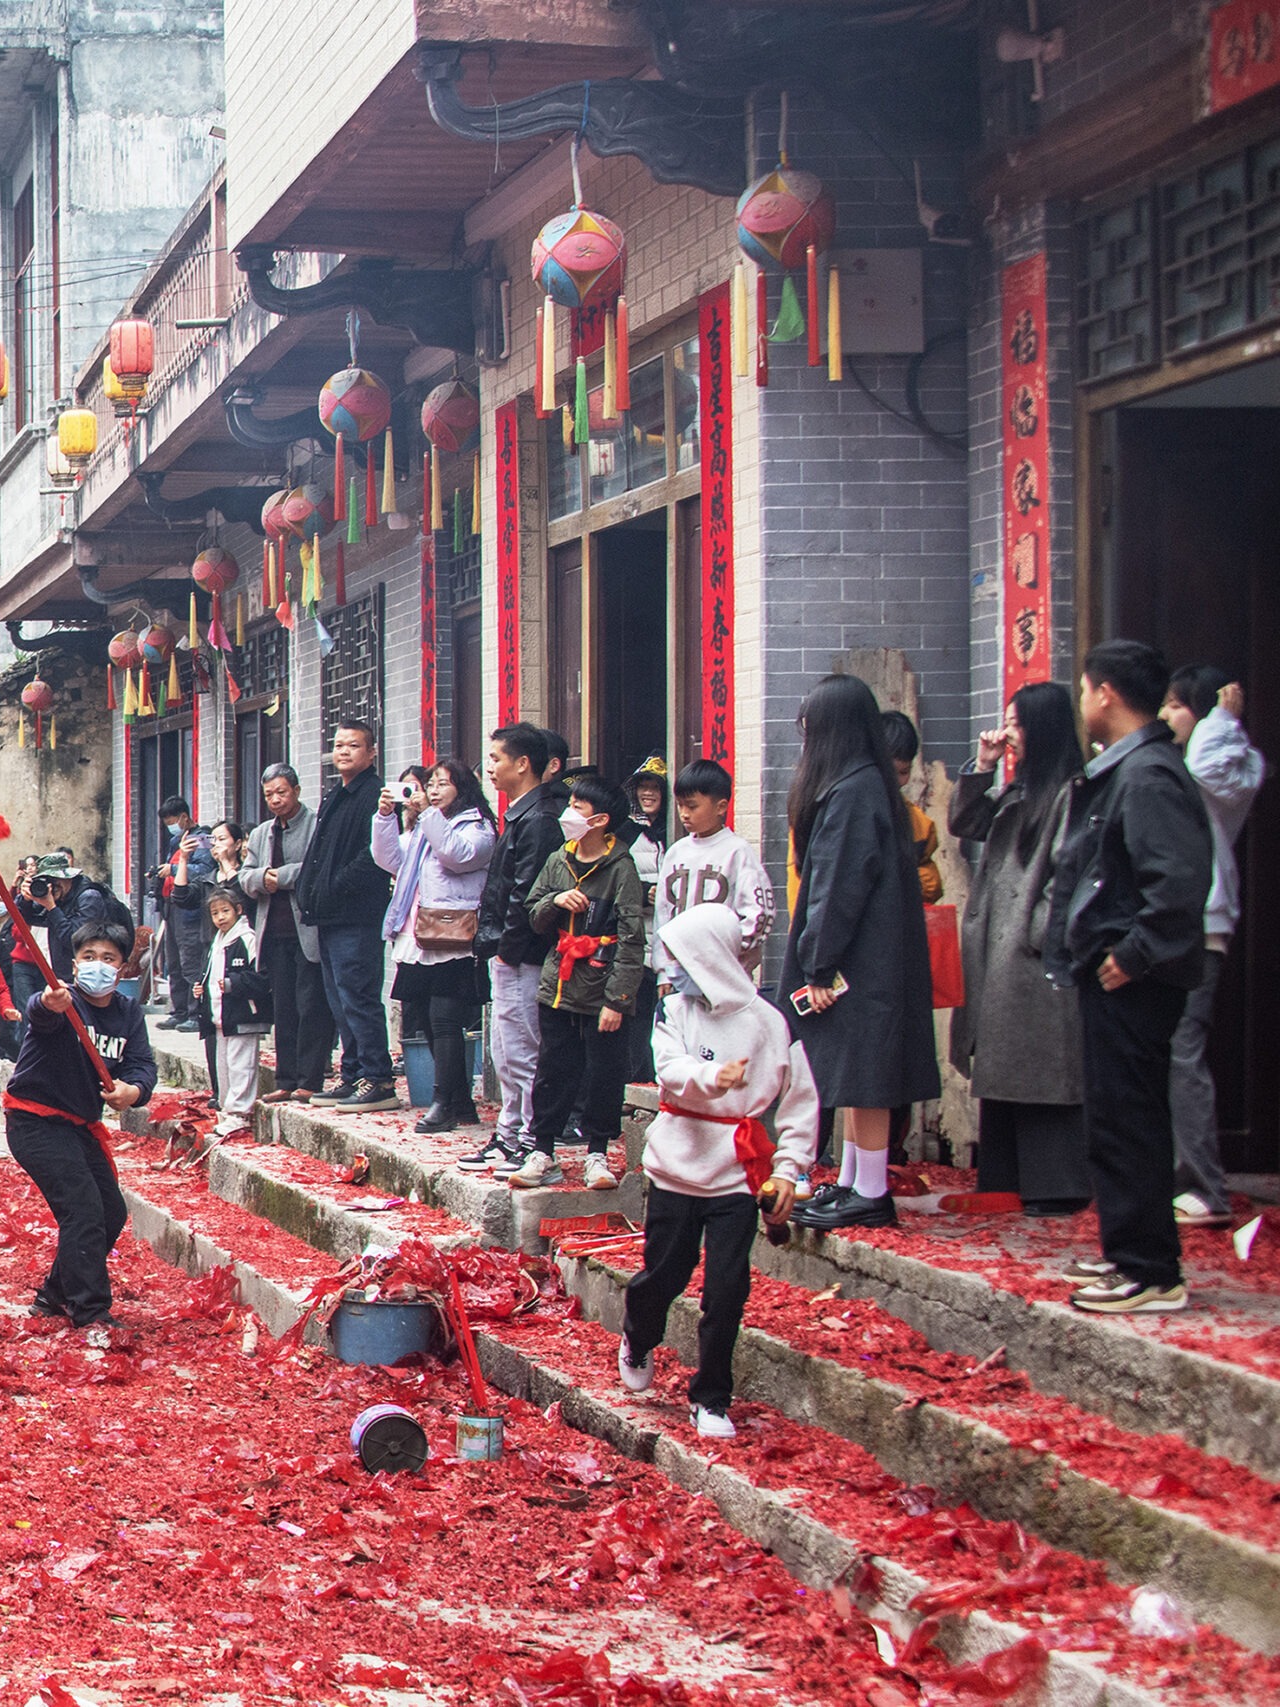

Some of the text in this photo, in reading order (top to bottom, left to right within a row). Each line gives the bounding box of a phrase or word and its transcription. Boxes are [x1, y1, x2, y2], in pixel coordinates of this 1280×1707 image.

[1009, 308, 1040, 686] 福临家门事
